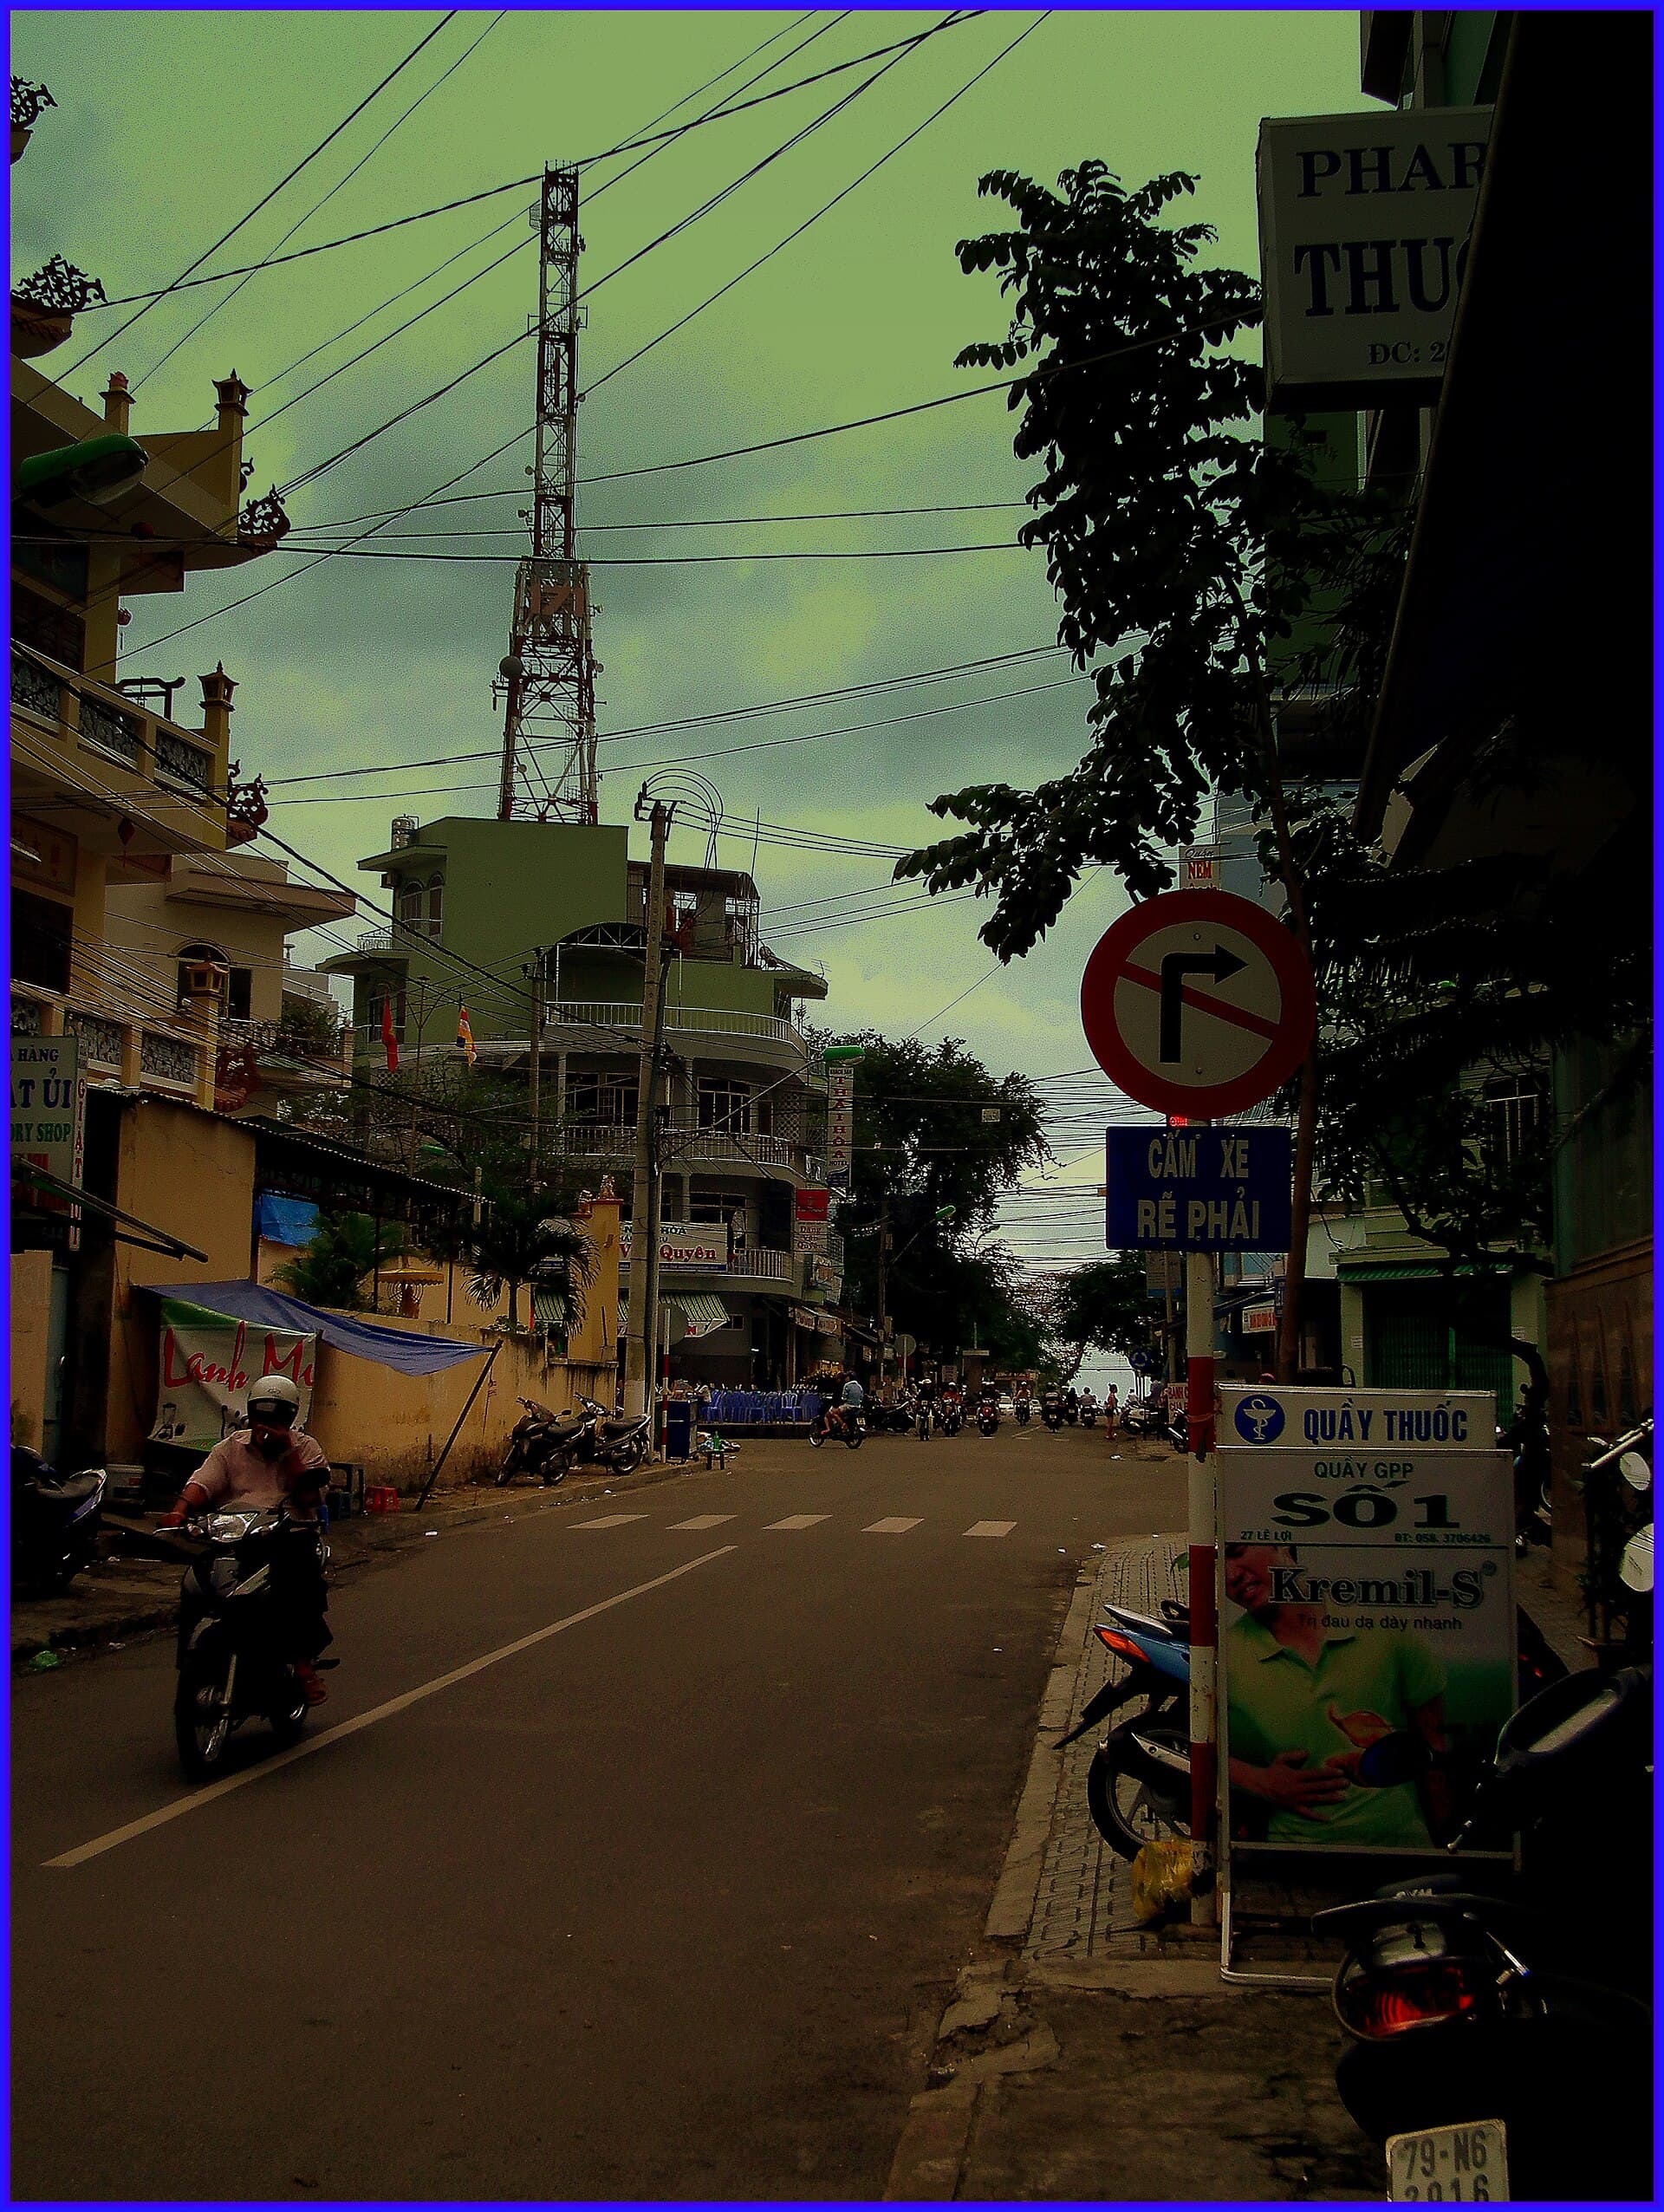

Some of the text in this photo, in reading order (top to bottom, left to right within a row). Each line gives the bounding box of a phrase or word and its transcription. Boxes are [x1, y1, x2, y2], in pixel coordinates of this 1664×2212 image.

[1368, 341, 1448, 366] ĐC: 2
[18, 1044, 60, 1063] HÀNG
[42, 1067, 73, 1109] ỦI
[36, 1122, 71, 1142] SHOP
[1147, 1129, 1250, 1179] CẤM XE
[1137, 1186, 1261, 1239] RẼ PHẢI
[1303, 1397, 1467, 1445] QUẦY THUỐC
[1314, 1455, 1414, 1479] QUẦY GPP
[1271, 1480, 1460, 1528] SỐ 1
[1240, 1529, 1292, 1543] 27 LÊ LỢI
[1268, 1565, 1484, 1609] Kremil-S
[1322, 1614, 1349, 1628] đau
[1355, 1616, 1375, 1629] dạ
[1379, 1615, 1408, 1631] dày
[1414, 1616, 1462, 1630] nhanh
[1403, 2130, 1487, 2180] 79-N6
